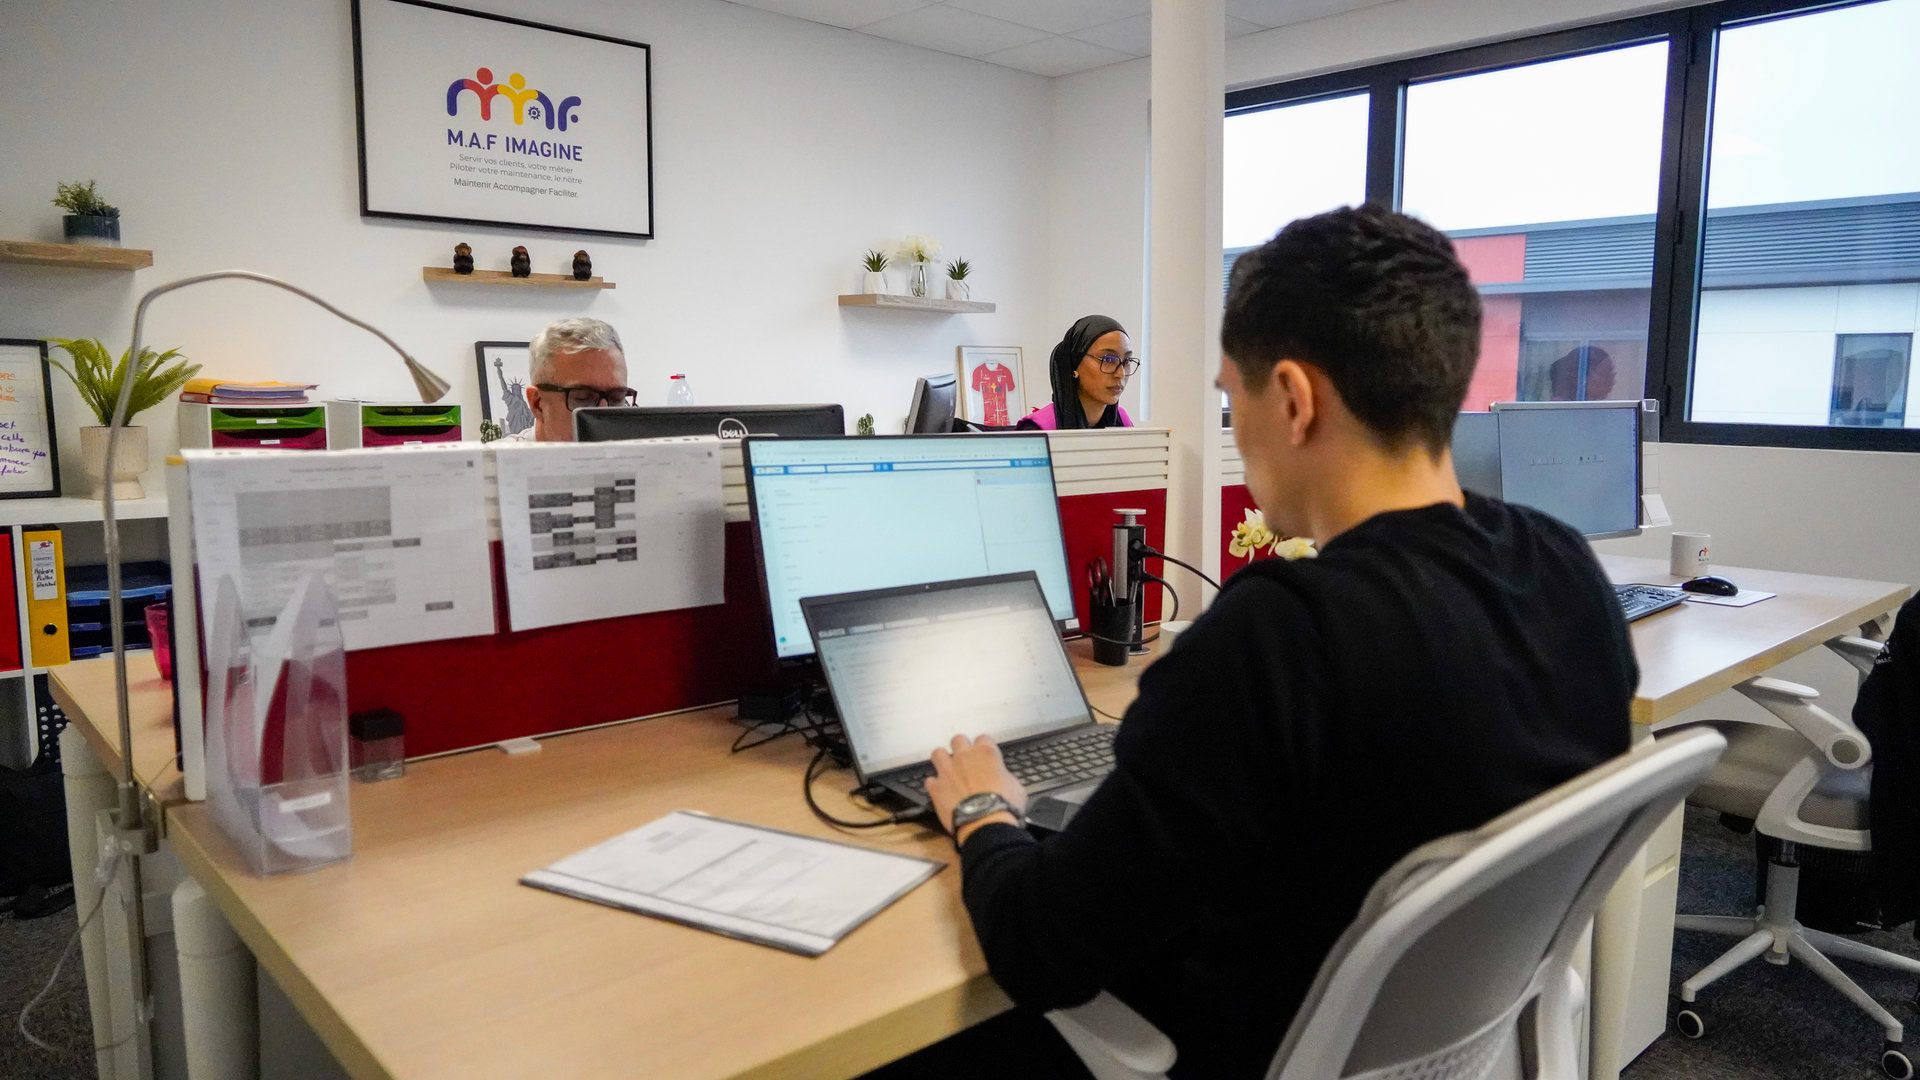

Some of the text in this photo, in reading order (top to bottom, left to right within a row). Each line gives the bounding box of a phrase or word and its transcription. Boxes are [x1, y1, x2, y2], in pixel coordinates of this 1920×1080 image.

[447, 128, 583, 162] M.A.F IMAGINE
[458, 153, 482, 163] Servir
[484, 157, 498, 165] vos
[528, 162, 548, 172] votre
[449, 162, 476, 173] Piloter
[478, 165, 499, 175] votre
[554, 174, 562, 183] le
[453, 177, 492, 189] Maintenir
[493, 181, 548, 195] Accompagner
[721, 429, 746, 438] DELL
